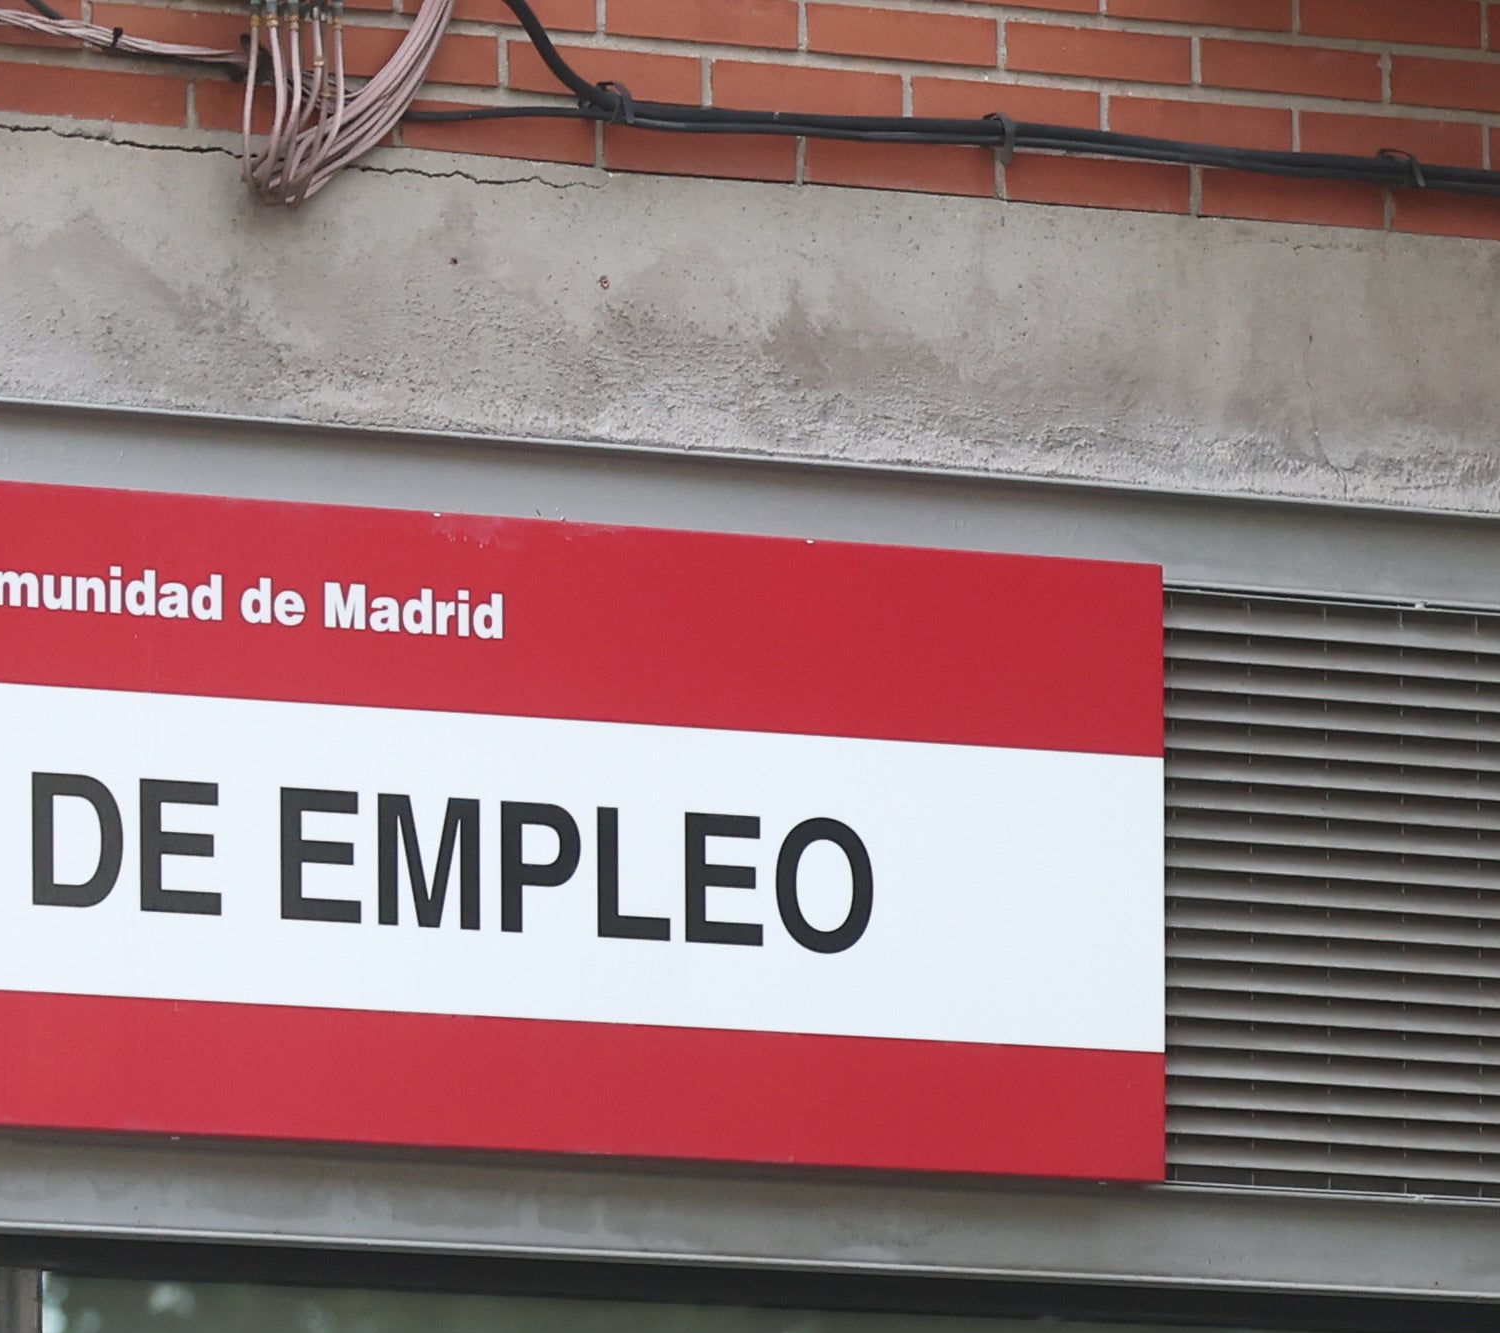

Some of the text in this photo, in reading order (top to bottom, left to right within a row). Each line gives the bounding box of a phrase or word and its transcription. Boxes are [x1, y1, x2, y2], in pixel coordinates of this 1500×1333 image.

[239, 575, 305, 628] de
[322, 584, 503, 640] Madrid
[28, 770, 223, 917] DE
[279, 785, 876, 955] EMPLEO
